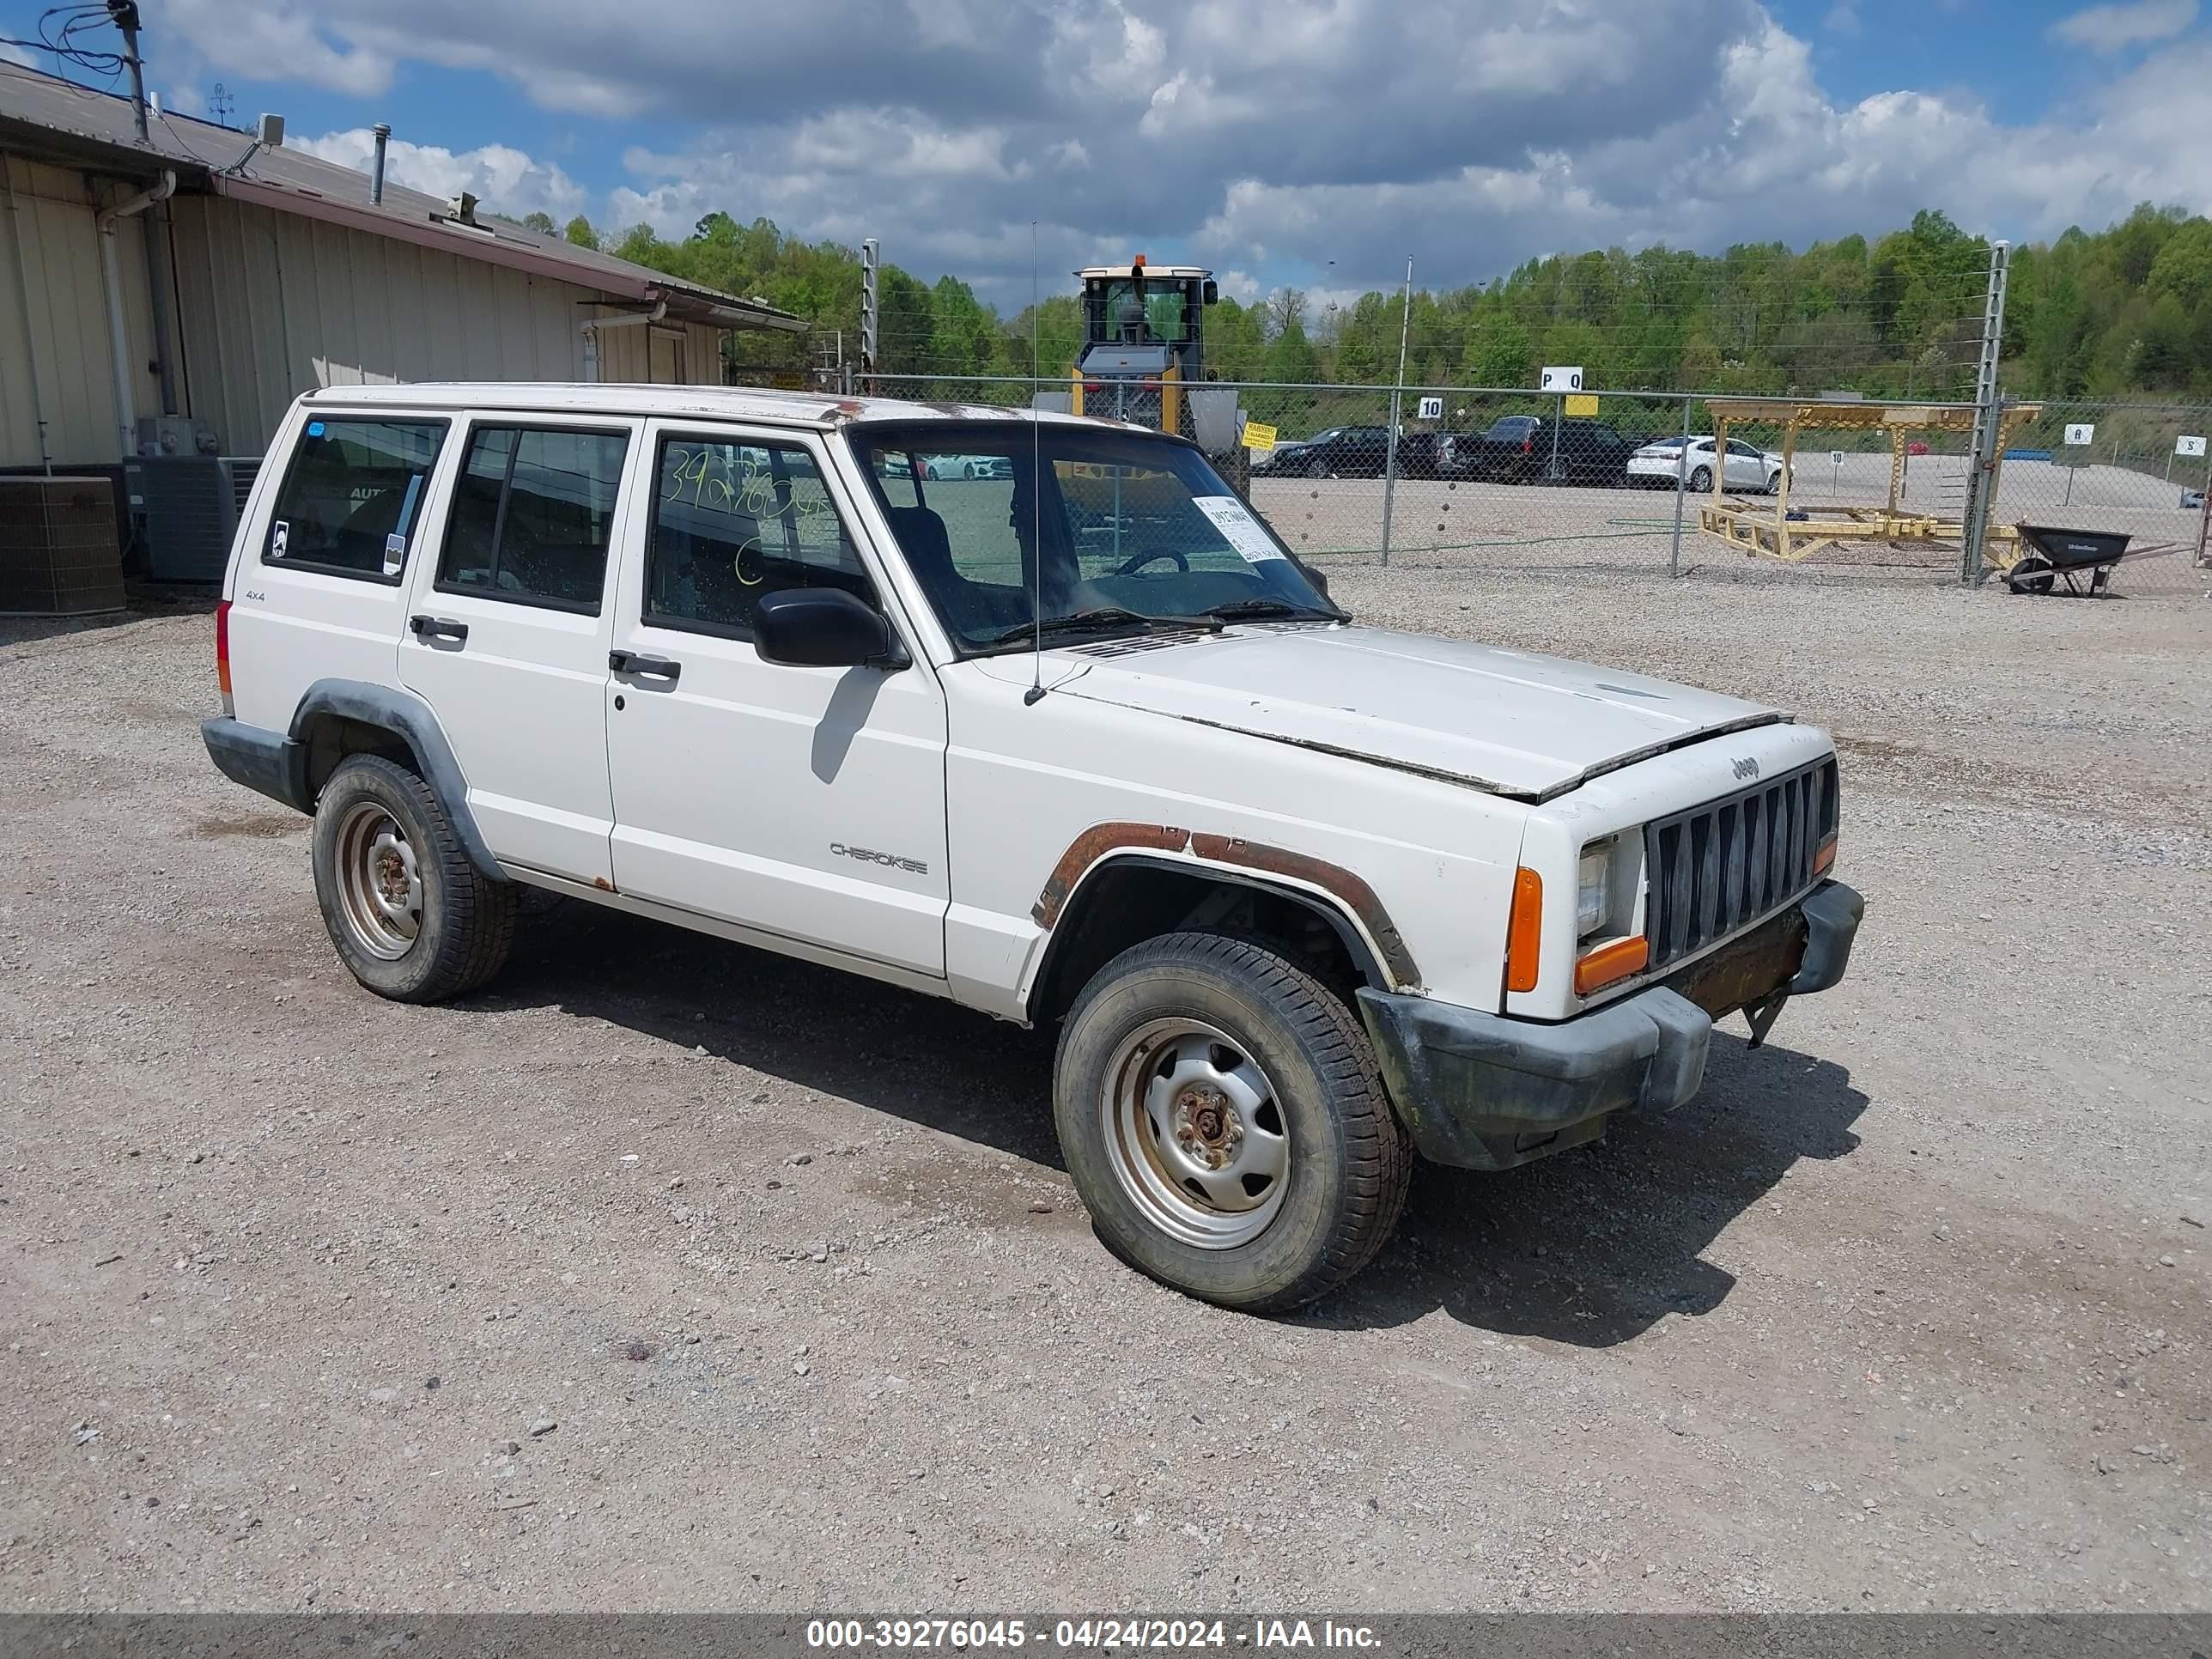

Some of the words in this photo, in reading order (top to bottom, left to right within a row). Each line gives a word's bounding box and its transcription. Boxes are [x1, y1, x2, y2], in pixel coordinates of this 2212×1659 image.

[1543, 374, 1553, 387] P
[1571, 374, 1581, 389] Q
[1424, 399, 1439, 416] 10
[2075, 429, 2082, 440] R
[2187, 441, 2195, 451] S
[1833, 453, 1842, 464] 10
[1730, 757, 1759, 780] Jeep
[830, 842, 928, 875] CHEROKEE
